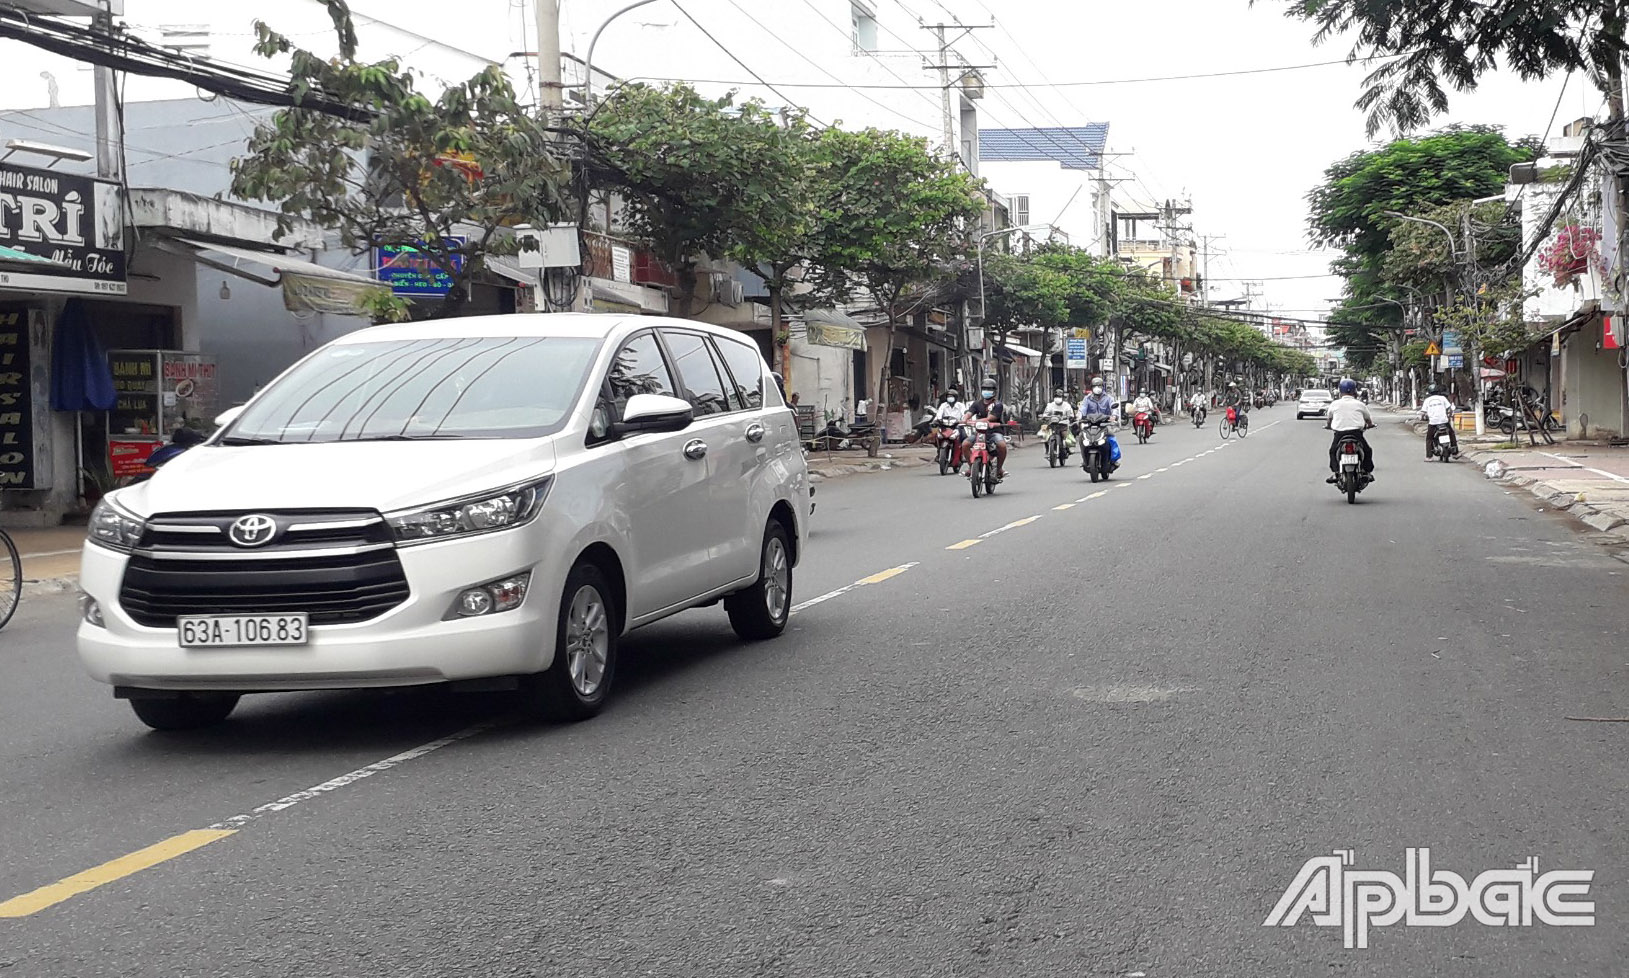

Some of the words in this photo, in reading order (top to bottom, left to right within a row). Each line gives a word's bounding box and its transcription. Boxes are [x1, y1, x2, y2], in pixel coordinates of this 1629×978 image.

[0, 170, 24, 189] HAIR
[26, 174, 59, 194] SALON
[183, 617, 303, 644] 63A-106.83
